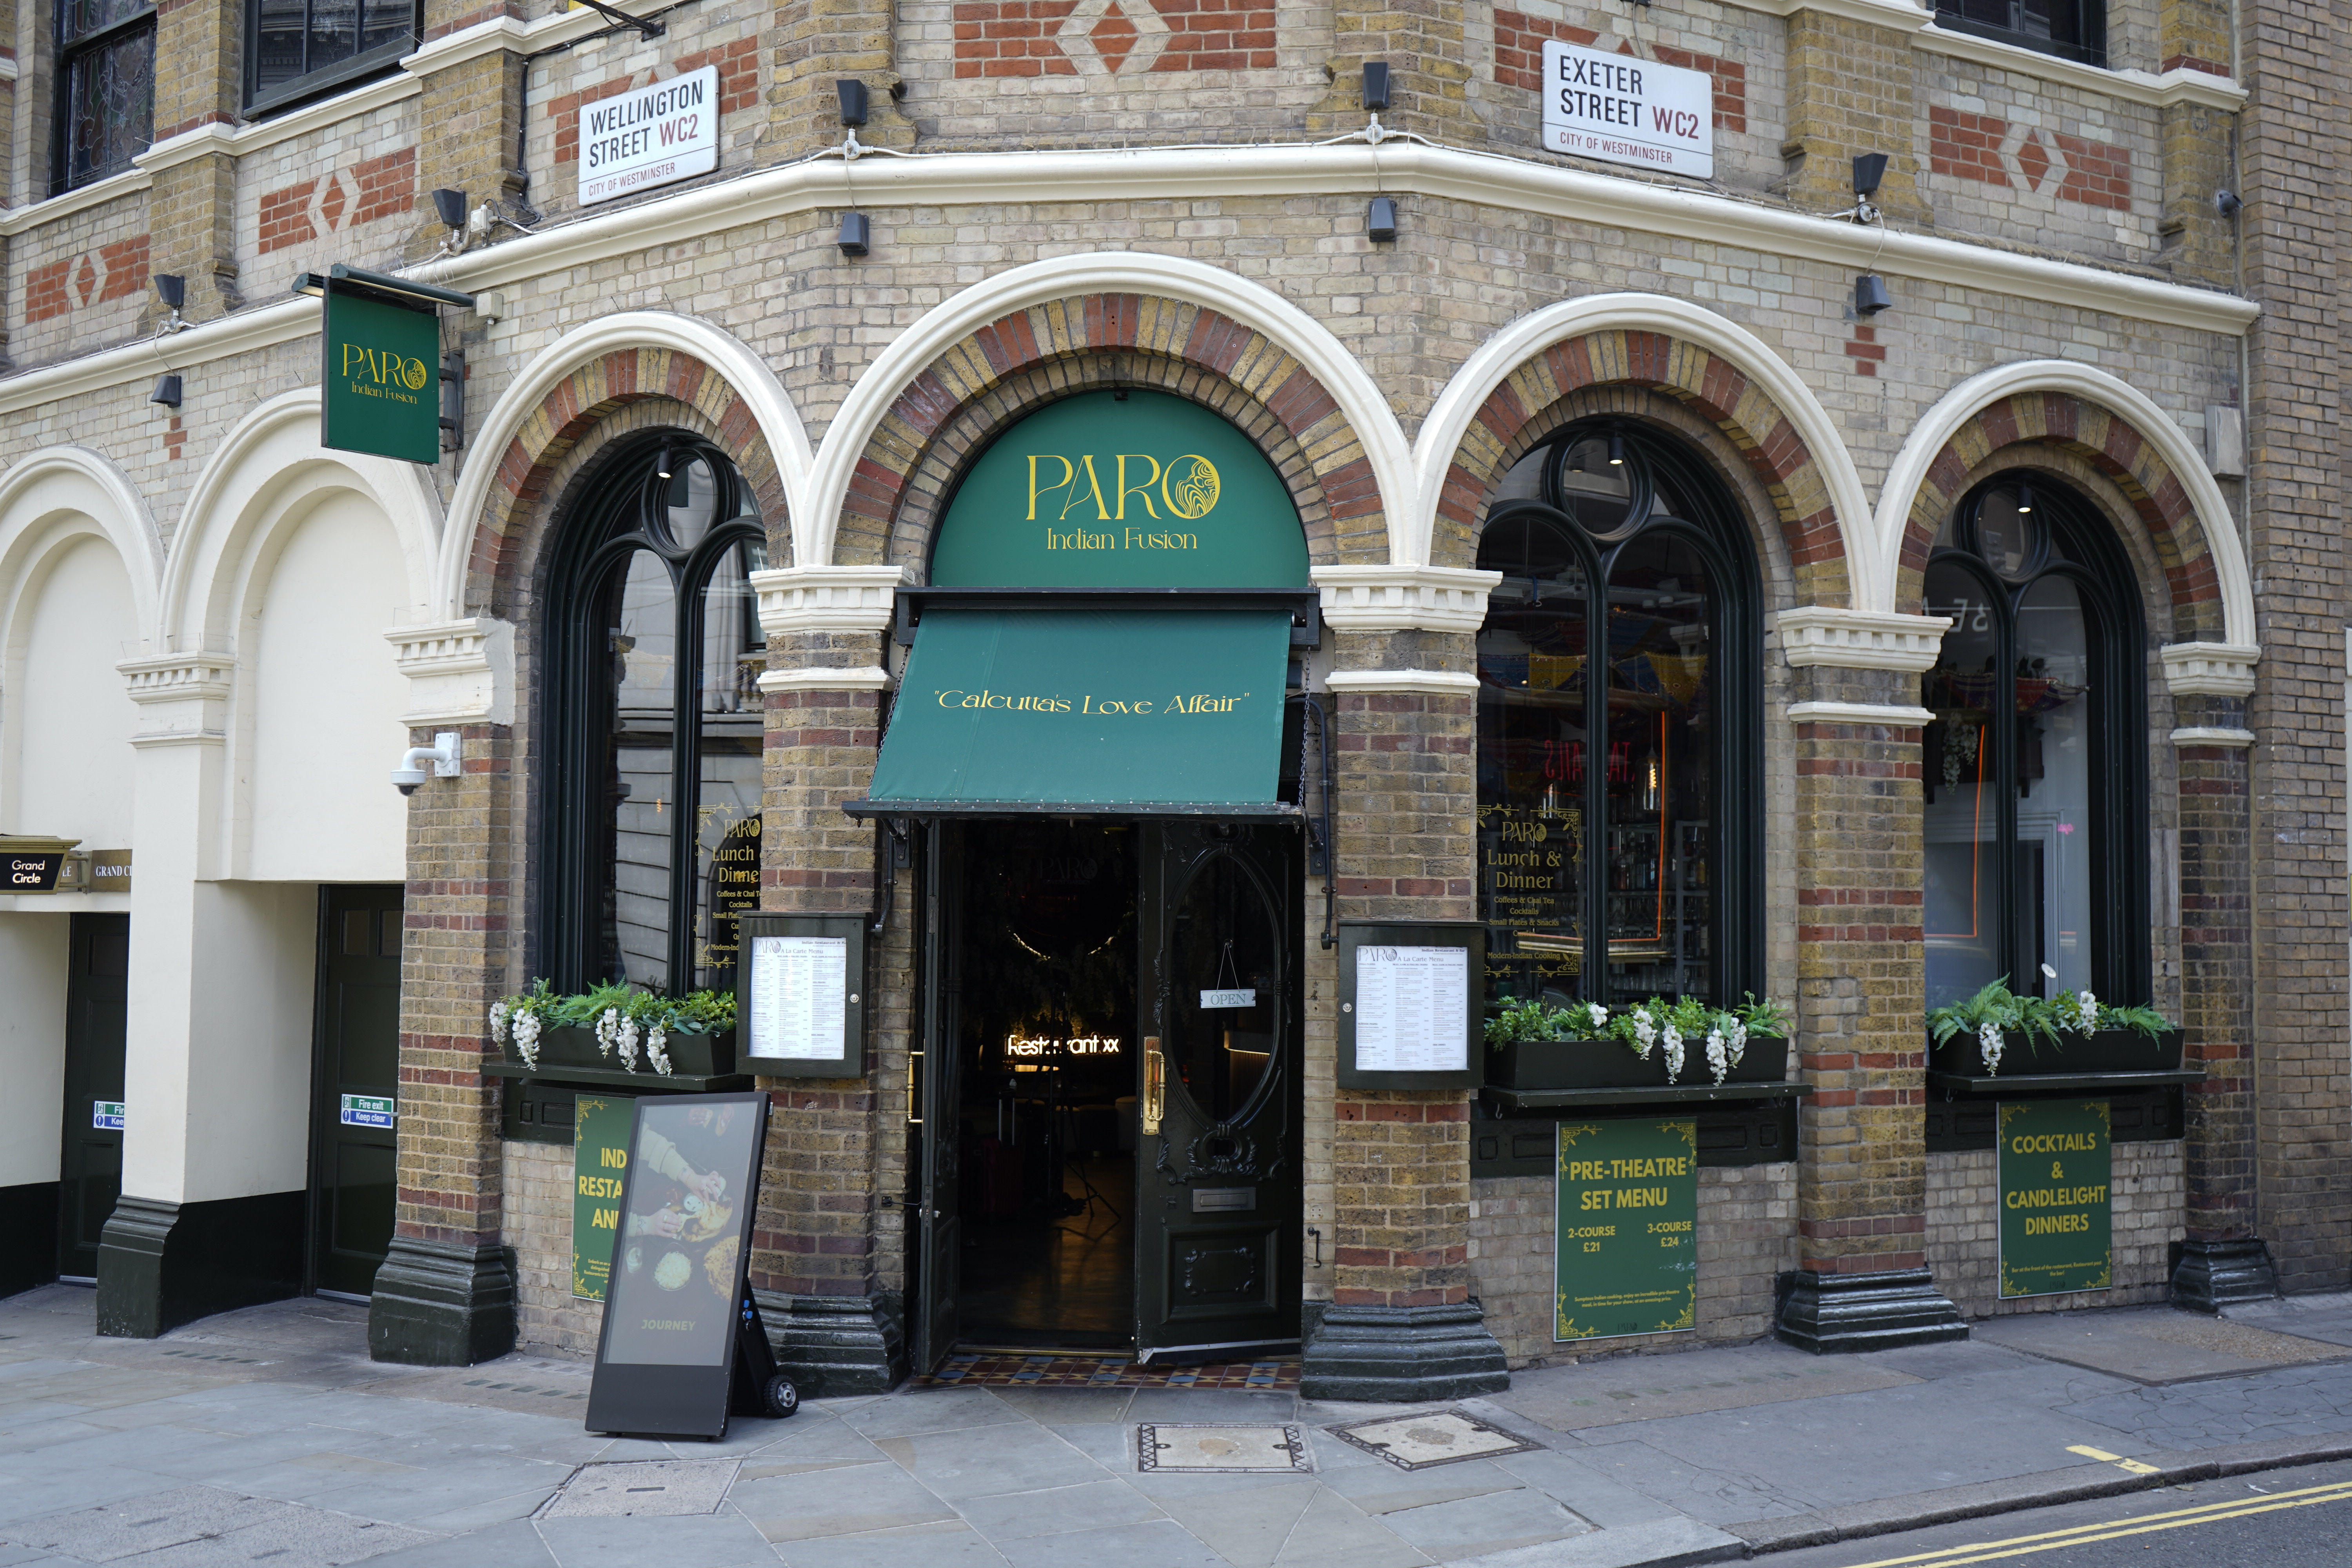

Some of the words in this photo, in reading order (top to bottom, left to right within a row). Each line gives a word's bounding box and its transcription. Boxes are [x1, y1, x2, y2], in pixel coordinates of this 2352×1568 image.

[1560, 55, 1642, 95] EXETER
[591, 79, 702, 136] WELLINGTON
[1561, 89, 1642, 127] STREET
[1653, 106, 1699, 139] WC2
[590, 127, 651, 167] STREET
[659, 113, 698, 147] WC2
[1560, 132, 1581, 147] CITY
[1587, 137, 1598, 149] OF
[1602, 140, 1672, 164] WESTMINSTER
[589, 181, 604, 196] CITY
[608, 178, 618, 190] OF
[620, 162, 675, 187] WESTMINSTER
[342, 343, 426, 390] PARO
[352, 381, 382, 398] Indian
[385, 388, 417, 404] Fusion
[1025, 454, 1220, 520] PARO
[1047, 528, 1114, 549] Indian
[1125, 528, 1197, 549] Fusion
[935, 690, 1071, 712] "Calcutta's
[1082, 695, 1152, 714] Love
[1164, 692, 1250, 713] Affair"
[724, 819, 761, 838] PARO
[1502, 822, 1547, 842] PARO
[712, 846, 754, 862] Lunch
[1488, 849, 1539, 866] Lunch
[1547, 851, 1561, 867] &
[12, 860, 45, 871] Grand
[96, 866, 122, 877] GRAND
[1039, 857, 1098, 879] PARO
[12, 873, 41, 884] Circle
[1496, 871, 1553, 888] Dinner
[755, 940, 781, 953] PARO
[1359, 948, 1397, 962] PARO
[1210, 993, 1246, 1006] OPEN
[1103, 1038, 1119, 1053] xx
[114, 1105, 124, 1114] Fir
[359, 1099, 371, 1109] Fire
[372, 1101, 384, 1110] exit
[111, 1117, 124, 1125] Kee
[356, 1112, 370, 1123] Keep
[371, 1114, 386, 1123] clear
[2012, 1132, 2096, 1154] COCKTAILS
[1570, 1157, 1686, 1180] PRE-THEATRE
[2051, 1161, 2063, 1179] &
[1581, 1190, 1612, 1210] SET
[1616, 1188, 1668, 1208] MENU
[2006, 1185, 2106, 1209] CANDLELIGHT
[1568, 1226, 1615, 1238] 2-COURSE
[1647, 1221, 1692, 1234] 3-COURSE
[2025, 1214, 2089, 1235] DINNERS
[1583, 1241, 1600, 1252] £21
[1661, 1236, 1679, 1248] £24
[641, 1319, 696, 1332] JOURNEY
